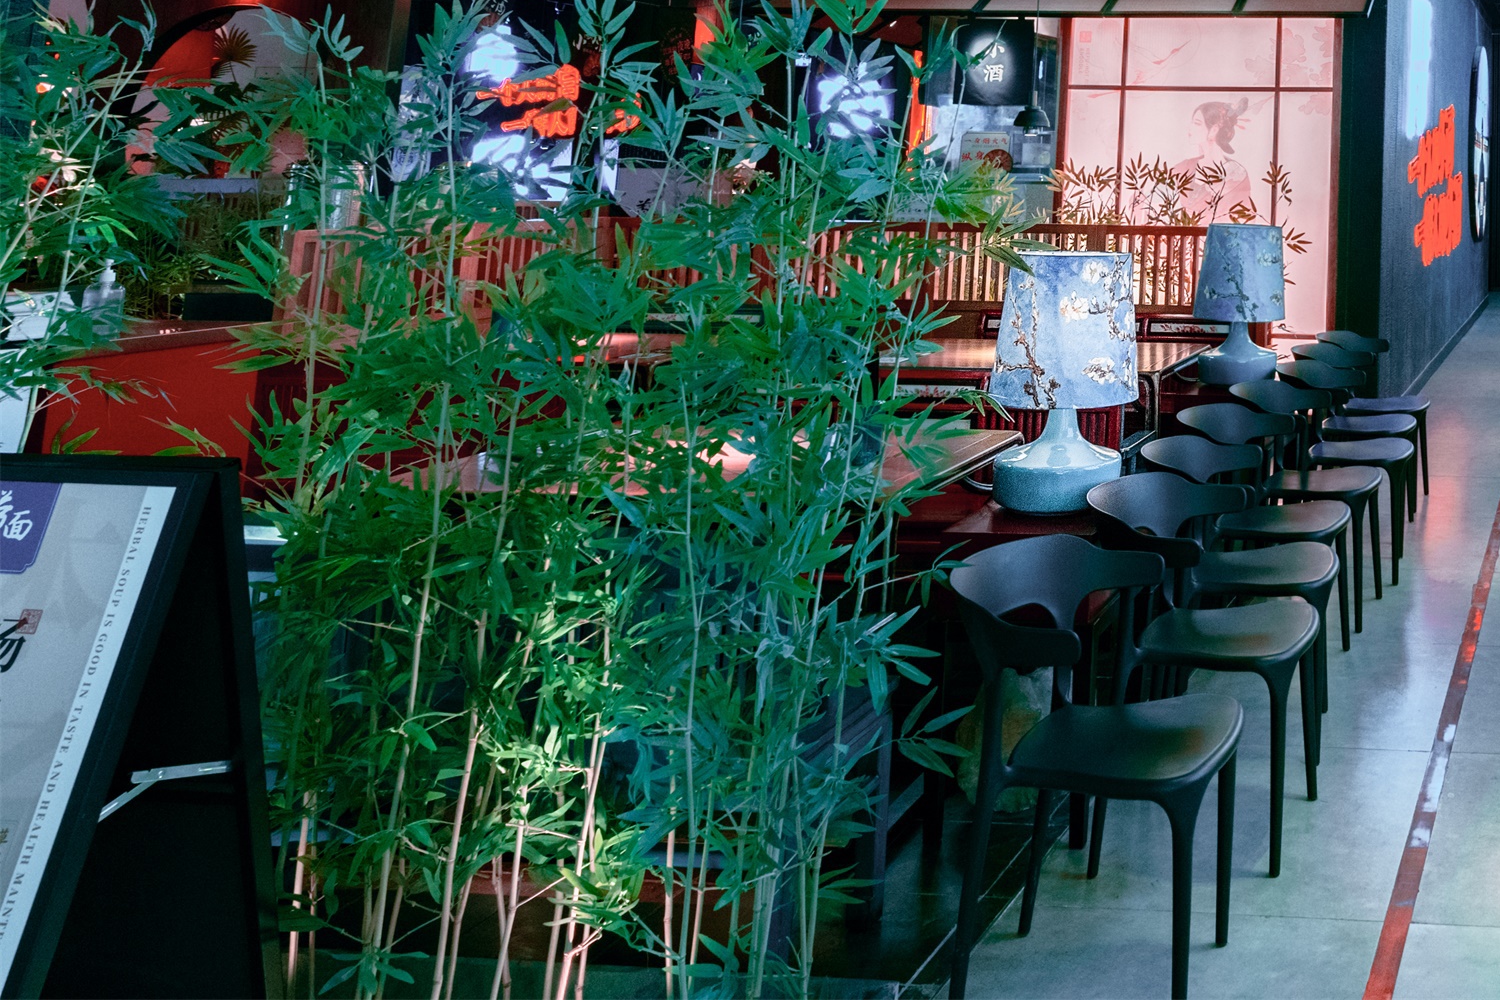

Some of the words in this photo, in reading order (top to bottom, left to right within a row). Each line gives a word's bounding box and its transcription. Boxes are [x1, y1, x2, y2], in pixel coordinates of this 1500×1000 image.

[125, 505, 152, 565] HERBAL
[111, 567, 131, 608] SOUP
[103, 612, 116, 628] IS
[86, 632, 109, 677] GOOD
[78, 681, 92, 700] IN
[58, 704, 84, 755] TASTE
[45, 760, 65, 794] AND
[19, 800, 50, 866] HEALTH
